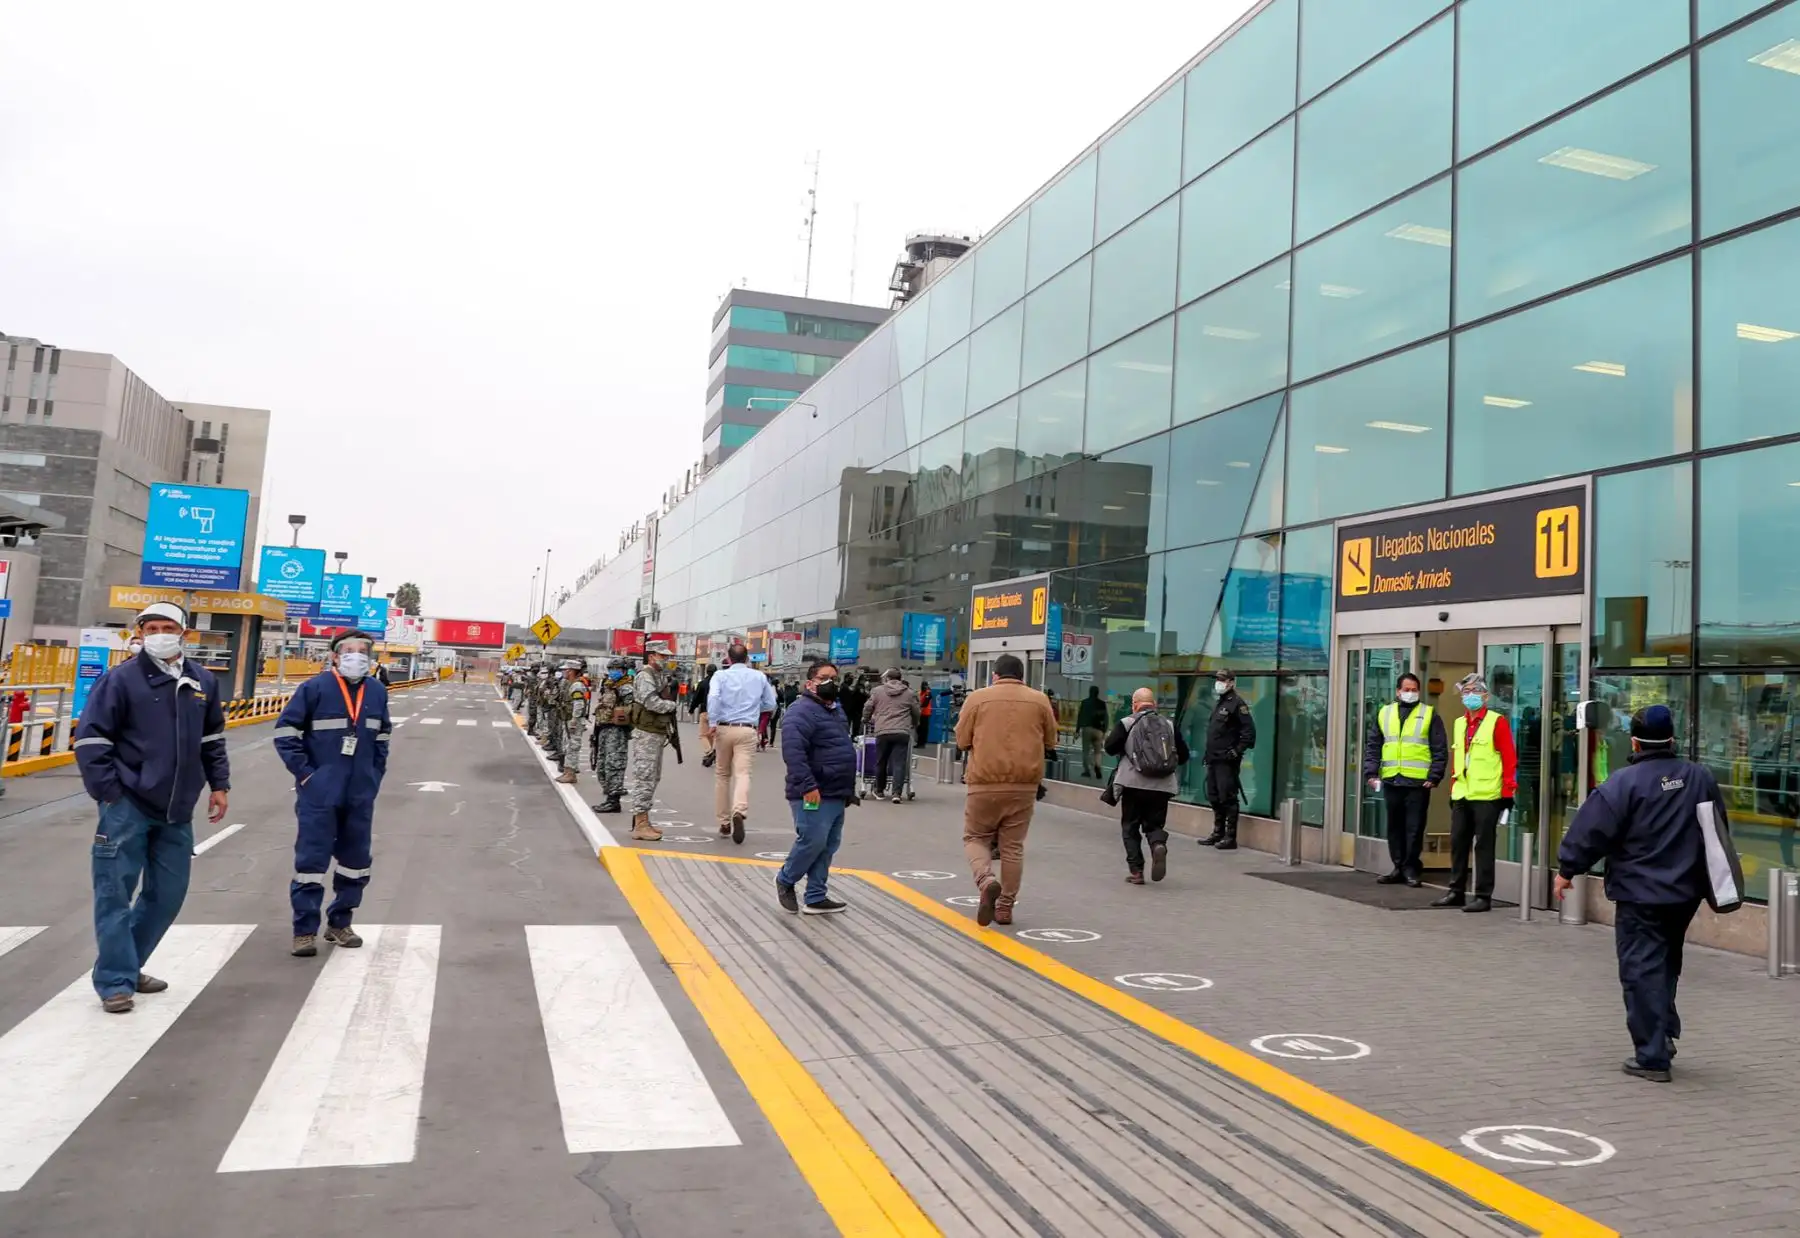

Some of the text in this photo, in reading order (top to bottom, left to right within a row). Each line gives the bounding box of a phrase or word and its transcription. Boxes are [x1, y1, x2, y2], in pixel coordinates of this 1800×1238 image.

[169, 544, 216, 553] temperatura
[1375, 520, 1495, 561] Llegadas Nacionales
[1541, 514, 1569, 569] 11
[1373, 567, 1452, 594] Domestic Arrivals
[191, 596, 208, 608] DE
[212, 597, 254, 610] PAGO
[1034, 592, 1045, 621] 10
